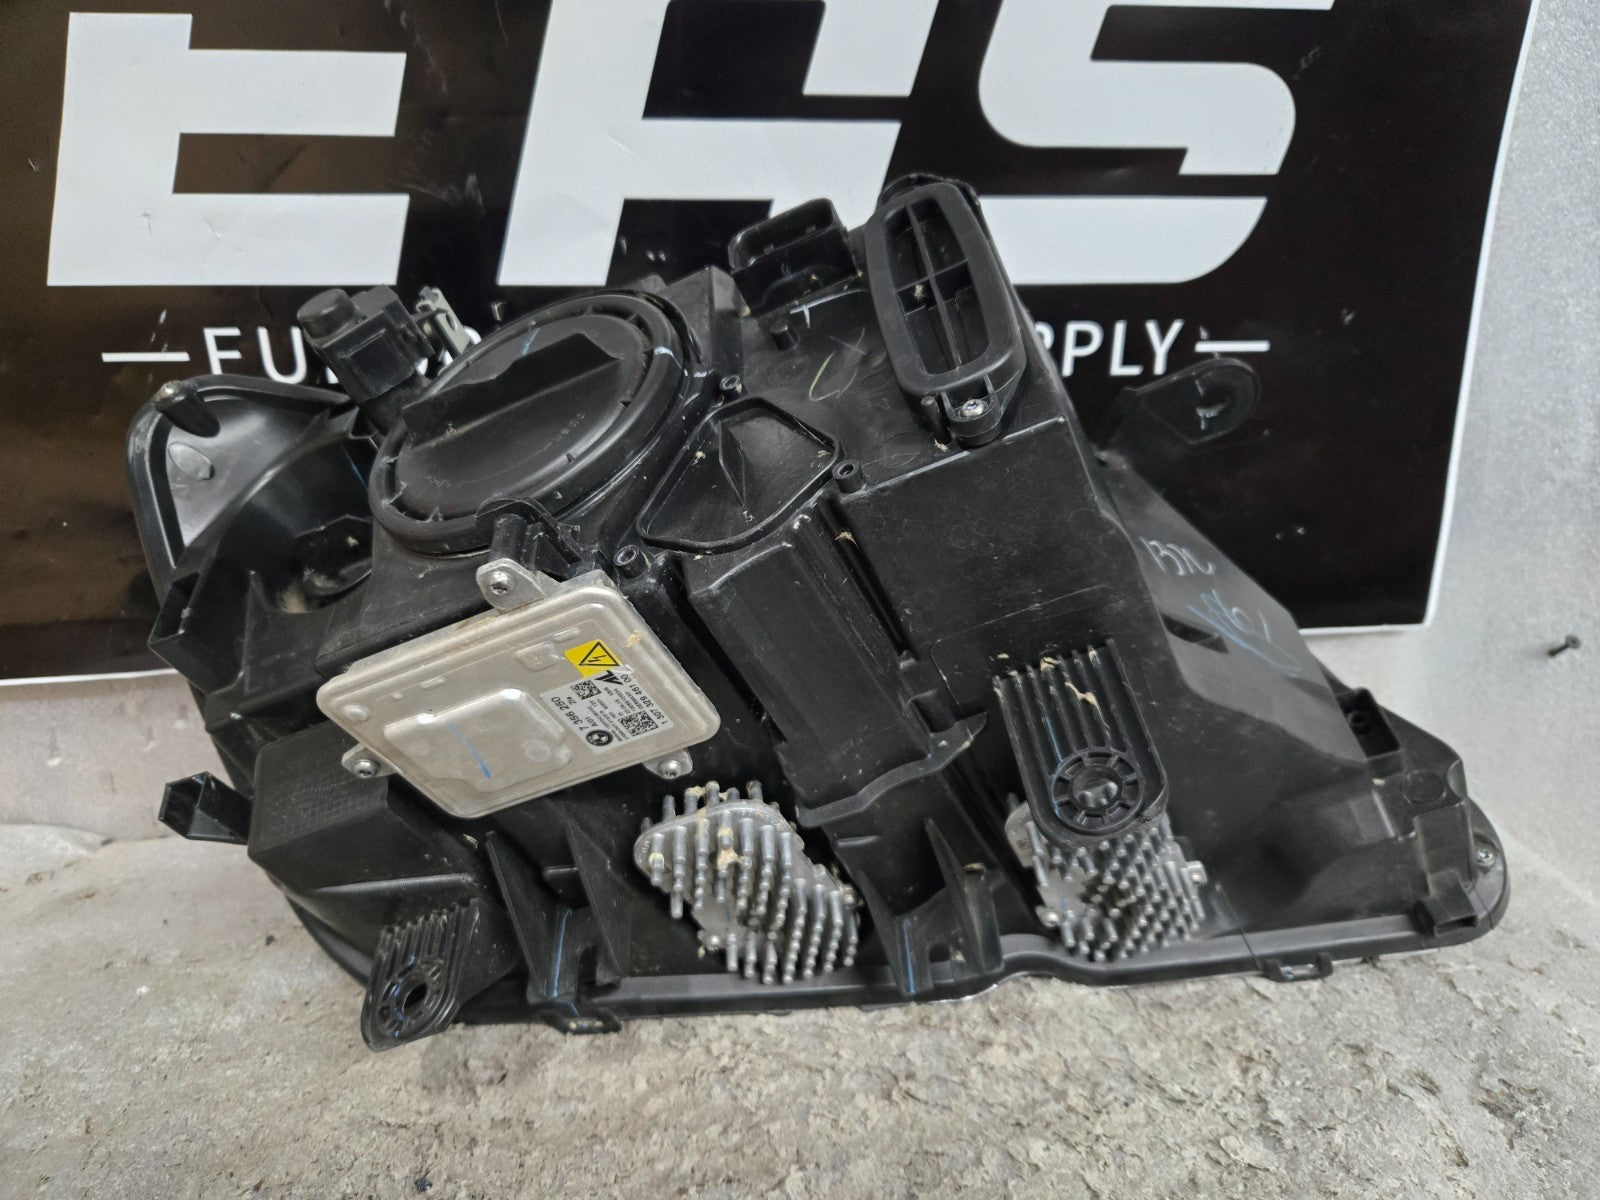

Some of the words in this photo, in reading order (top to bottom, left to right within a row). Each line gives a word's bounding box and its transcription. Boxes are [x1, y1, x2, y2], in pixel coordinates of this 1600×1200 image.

[618, 673, 632, 683] 00
[549, 695, 569, 710] 250
[638, 695, 655, 707] 329
[564, 710, 583, 725] 356
[649, 707, 665, 719] 307
